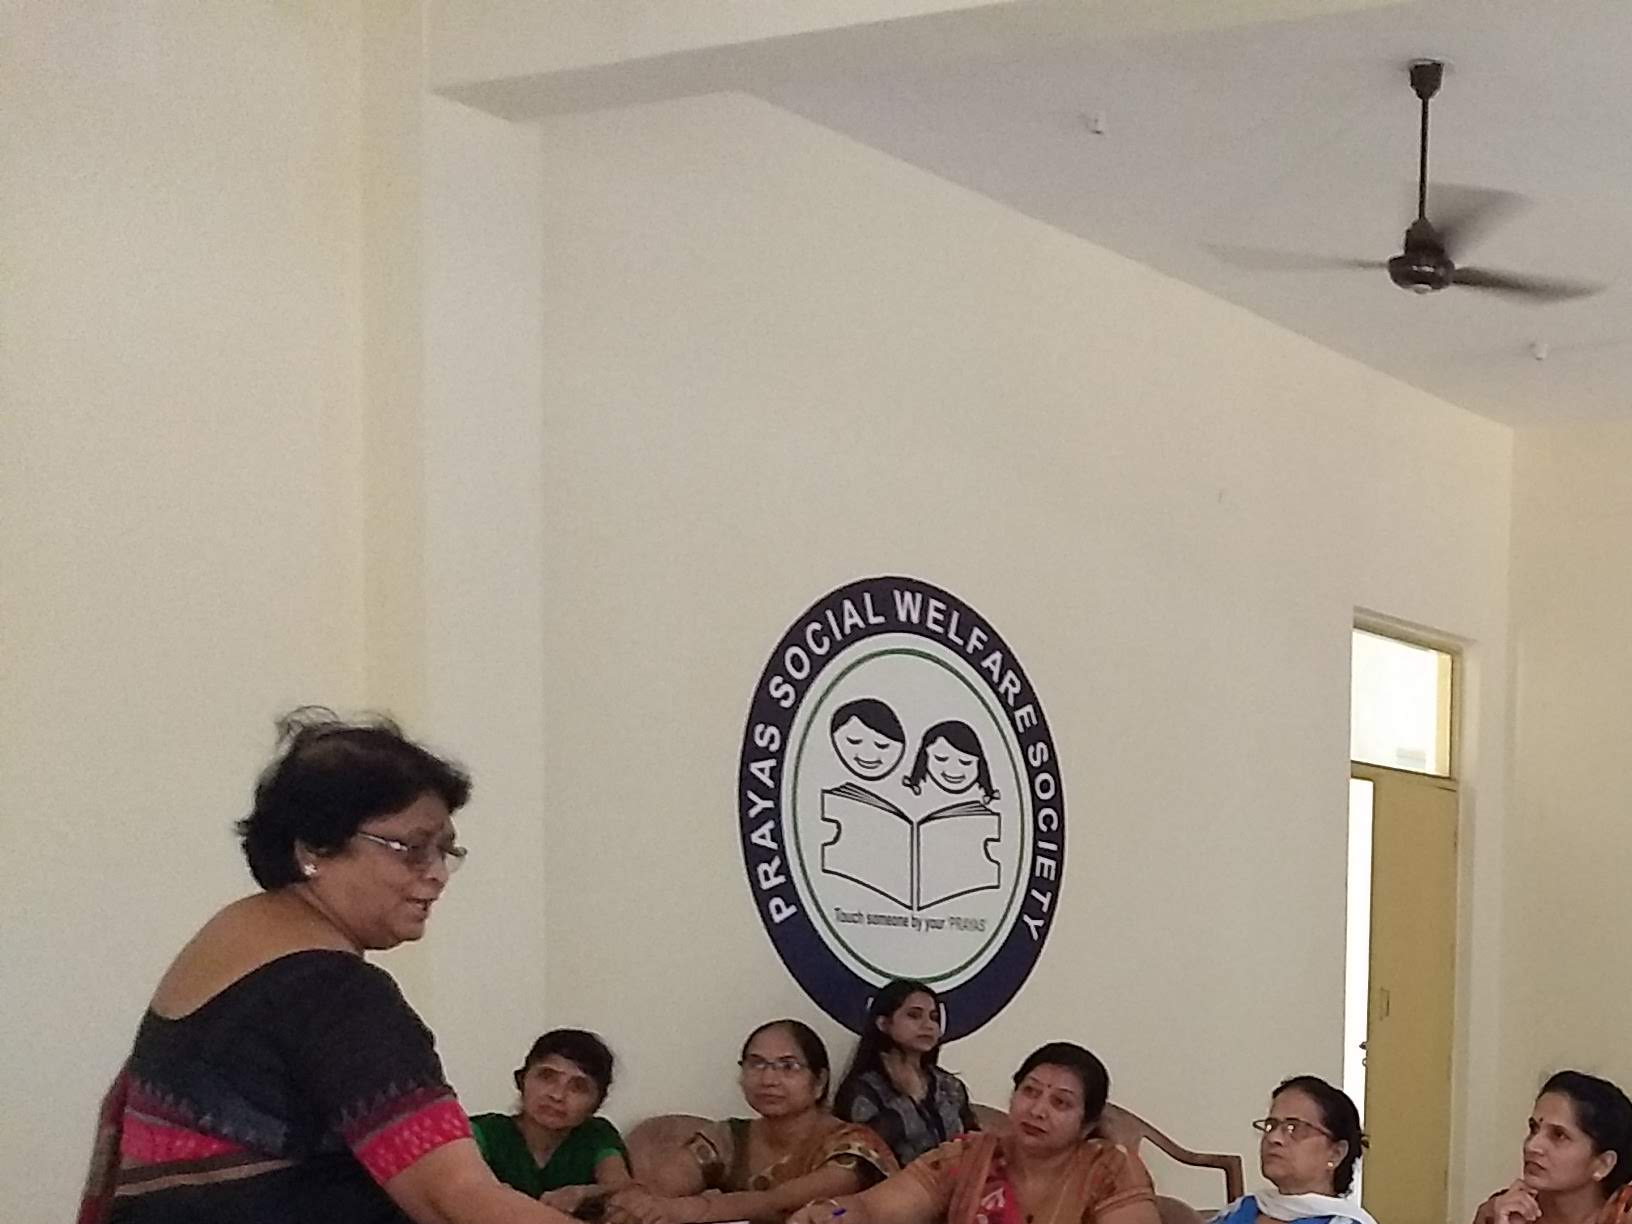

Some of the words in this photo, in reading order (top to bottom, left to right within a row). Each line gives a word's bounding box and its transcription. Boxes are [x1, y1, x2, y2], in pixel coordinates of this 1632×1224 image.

[770, 592, 886, 708] SOCIAL
[893, 589, 1038, 734] WELFARE
[747, 722, 798, 924] PRAYAS
[1022, 741, 1059, 943] SOCIETY
